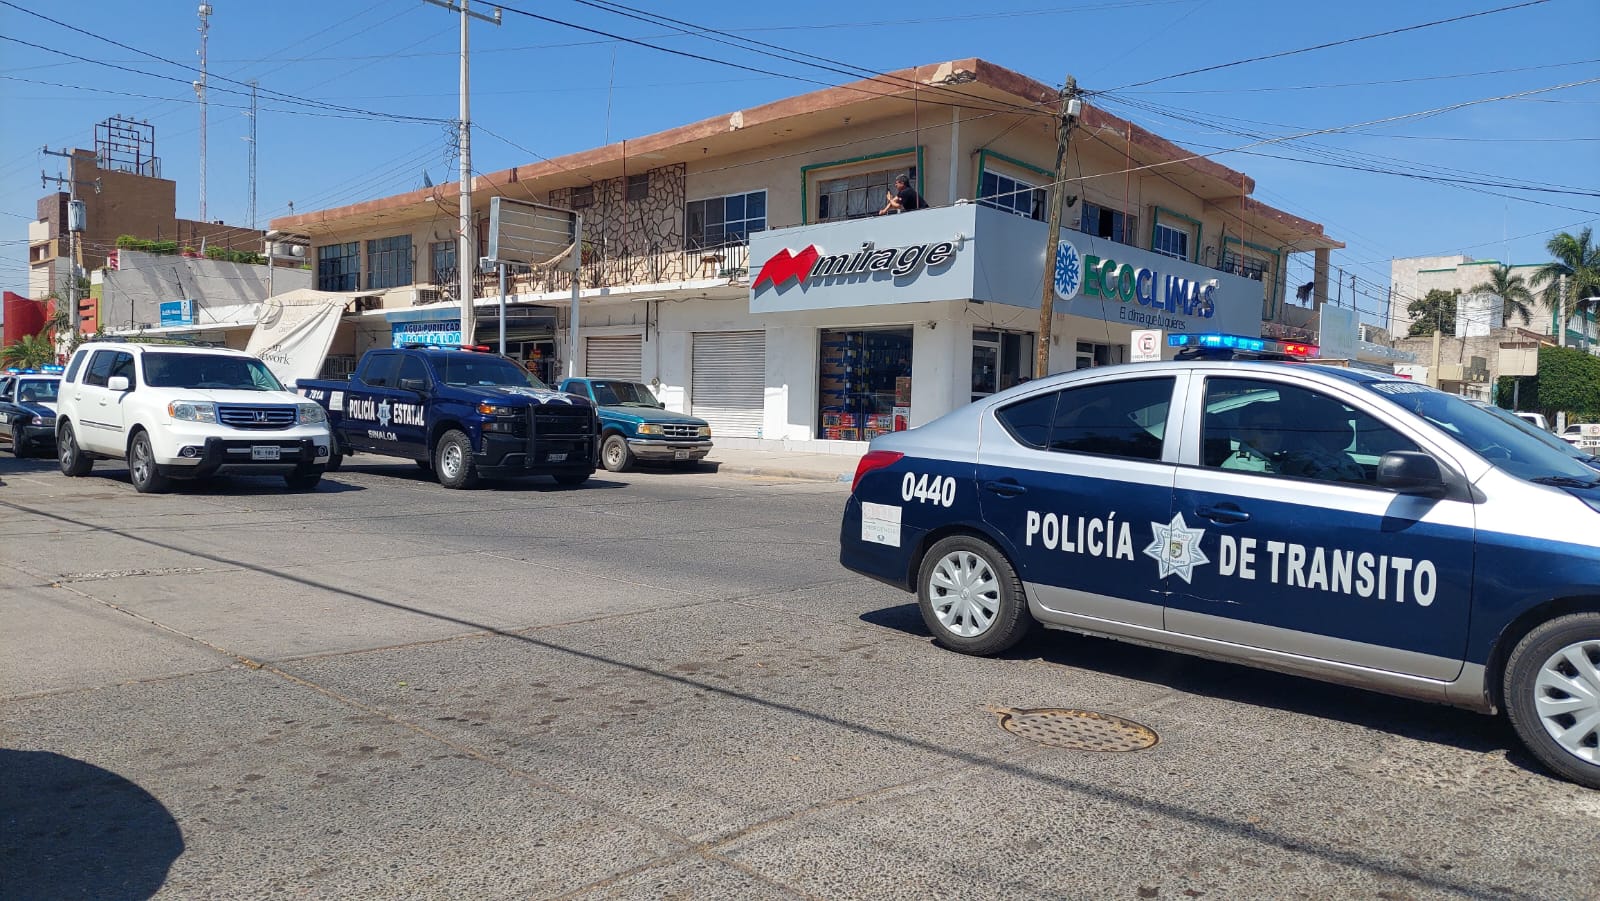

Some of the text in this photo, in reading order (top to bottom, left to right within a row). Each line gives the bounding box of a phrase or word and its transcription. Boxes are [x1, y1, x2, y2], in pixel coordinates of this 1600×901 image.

[810, 241, 953, 277] mirage
[1084, 254, 1215, 319] ECOCLIMAS
[404, 322, 460, 333] AGUA PURIFICAD
[1120, 306, 1126, 320] El
[1128, 309, 1145, 323] clima
[407, 333, 460, 343] ESMERALDA
[349, 397, 376, 421] POLICÍA
[393, 403, 425, 427] ESTATAL
[367, 430, 398, 441] SINALOA
[901, 471, 957, 508] 0440
[1025, 510, 1437, 607] POLICÍA DE TRANSITO
